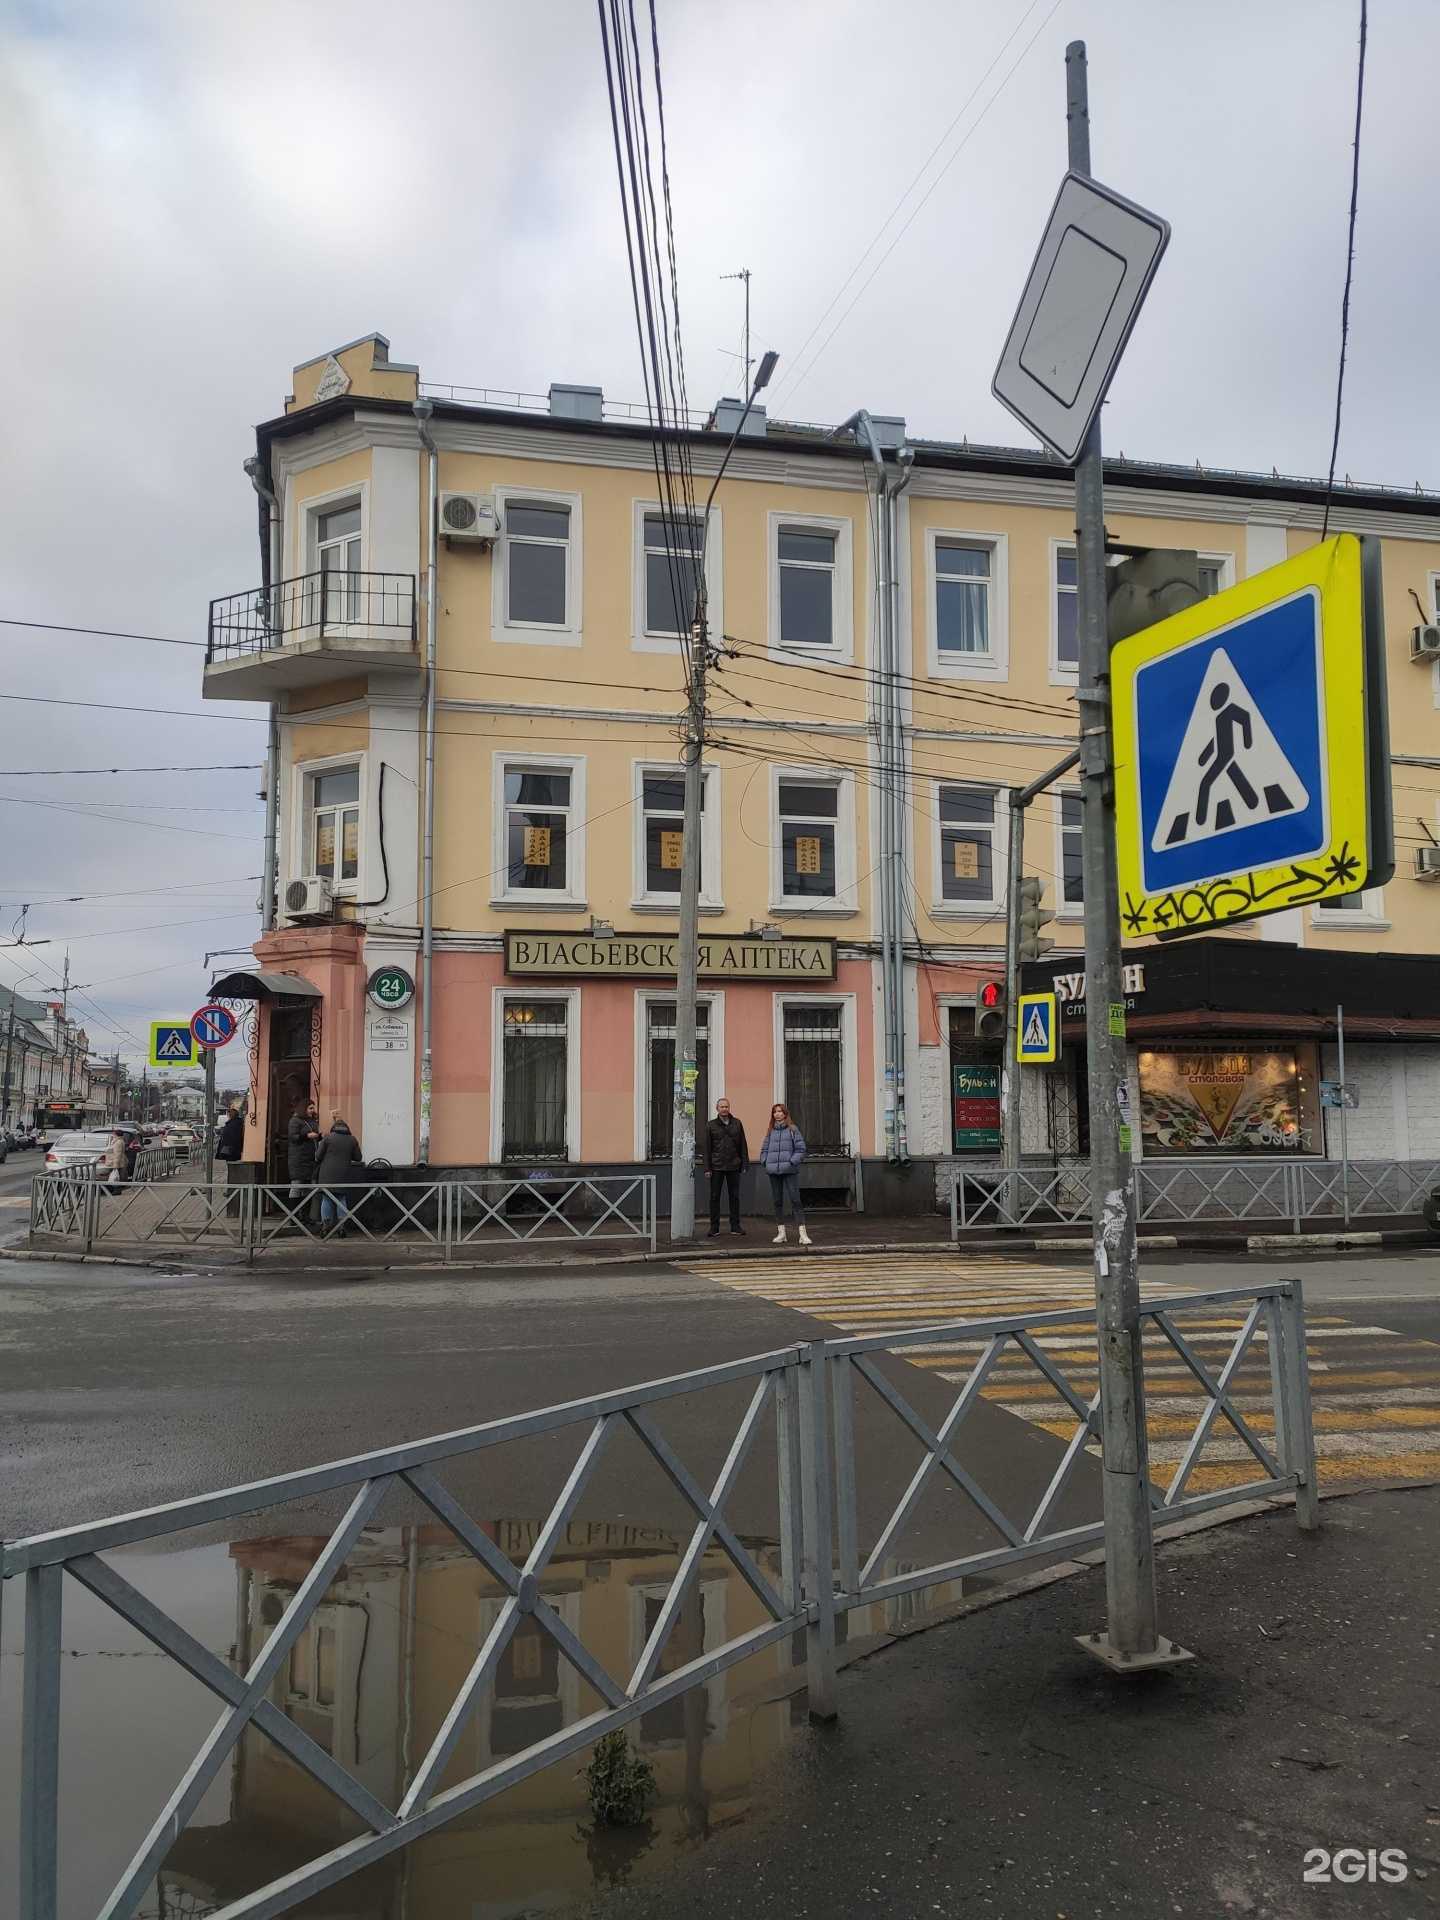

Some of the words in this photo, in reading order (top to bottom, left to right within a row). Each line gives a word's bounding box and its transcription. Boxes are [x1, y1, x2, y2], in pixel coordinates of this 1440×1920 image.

[514, 941, 713, 968] ВЛАСЬЕВСКЯ
[720, 946, 828, 971] АПТЕКА
[381, 978, 400, 992] 24
